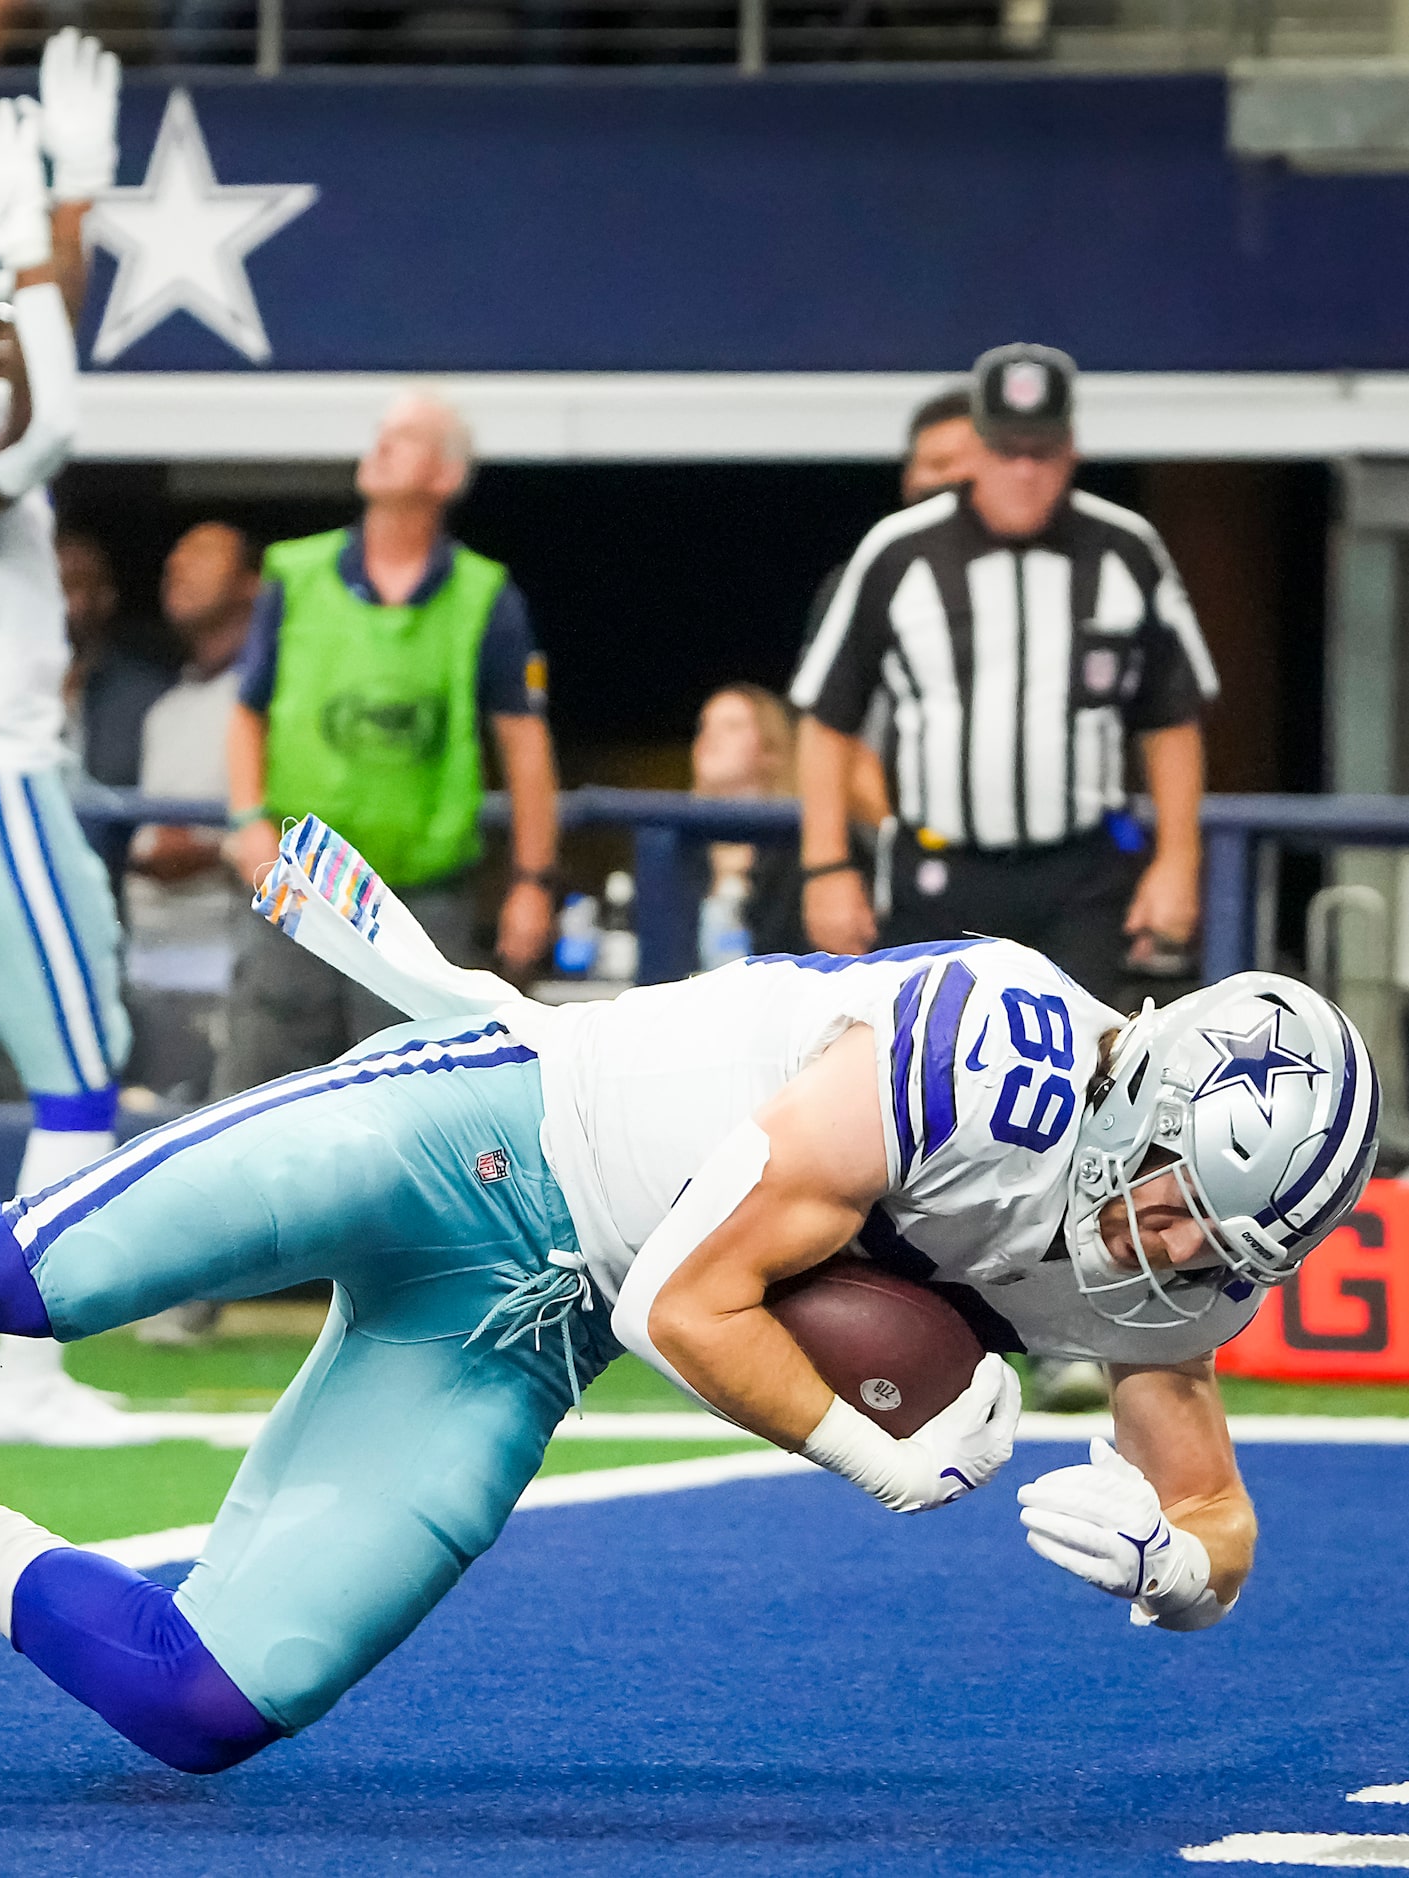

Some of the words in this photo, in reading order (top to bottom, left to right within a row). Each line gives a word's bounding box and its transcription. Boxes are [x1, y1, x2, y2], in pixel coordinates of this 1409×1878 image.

[990, 987, 1076, 1154] 89
[479, 1154, 496, 1179] NFL
[1282, 1210, 1389, 1353] G
